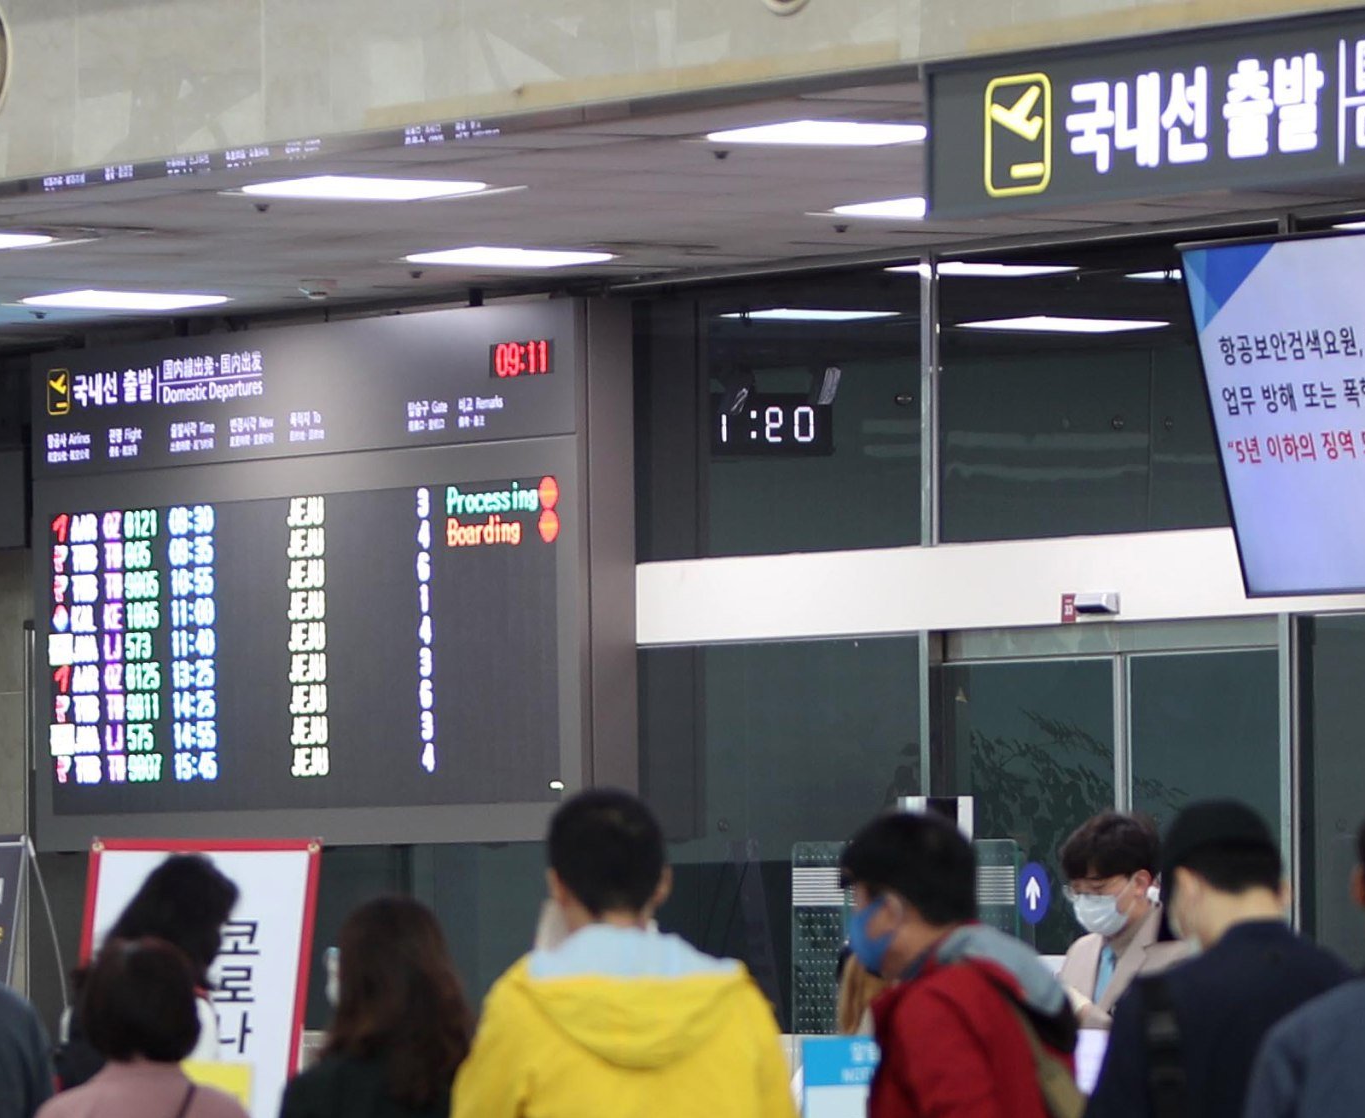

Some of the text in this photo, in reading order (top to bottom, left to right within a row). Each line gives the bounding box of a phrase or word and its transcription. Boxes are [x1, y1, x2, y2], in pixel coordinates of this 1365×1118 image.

[1065, 52, 1325, 172] 국내선 출발
[494, 340, 548, 377] 09:11
[1219, 325, 1364, 367] 항공보안검색요원,
[72, 367, 154, 407] 국내선 출발
[162, 379, 264, 403] Domestic Departures
[1221, 386, 1254, 416] 업무
[1261, 382, 1297, 414] 방해
[1302, 381, 1337, 409] 또는
[1227, 435, 1261, 465] “5년
[1266, 429, 1317, 464] 이하의
[1321, 429, 1355, 461] 징역
[286, 496, 325, 527] JEJU
[417, 487, 430, 518] 3
[446, 481, 539, 515] Processing
[286, 527, 325, 559] JEJU
[417, 519, 431, 550] 4
[446, 524, 522, 548] Boarding
[169, 566, 215, 596] 10:55
[287, 558, 325, 590] JEJU
[417, 551, 431, 582] 6
[69, 604, 98, 633] KAL
[103, 602, 124, 631] KE
[169, 597, 216, 628] 11:00
[287, 590, 326, 621] JEJU
[419, 583, 430, 613] 1
[103, 632, 123, 661] LJ
[124, 631, 153, 660] 573
[170, 627, 216, 658] 11:40
[288, 621, 327, 652] JEJU
[419, 614, 433, 645] 4
[171, 658, 216, 689] 13:25
[288, 652, 327, 683] JEJU
[419, 646, 432, 678] 3
[172, 689, 217, 721] 14:25
[289, 684, 328, 715] JEJU
[419, 678, 433, 710] 6
[105, 722, 125, 752] LJ
[126, 722, 155, 751] 575
[172, 720, 217, 751] 14:55
[290, 715, 329, 746] JEJU
[420, 709, 434, 741] 3
[173, 750, 218, 781] 15:45
[291, 746, 330, 778] JEJU
[421, 742, 435, 773] 4
